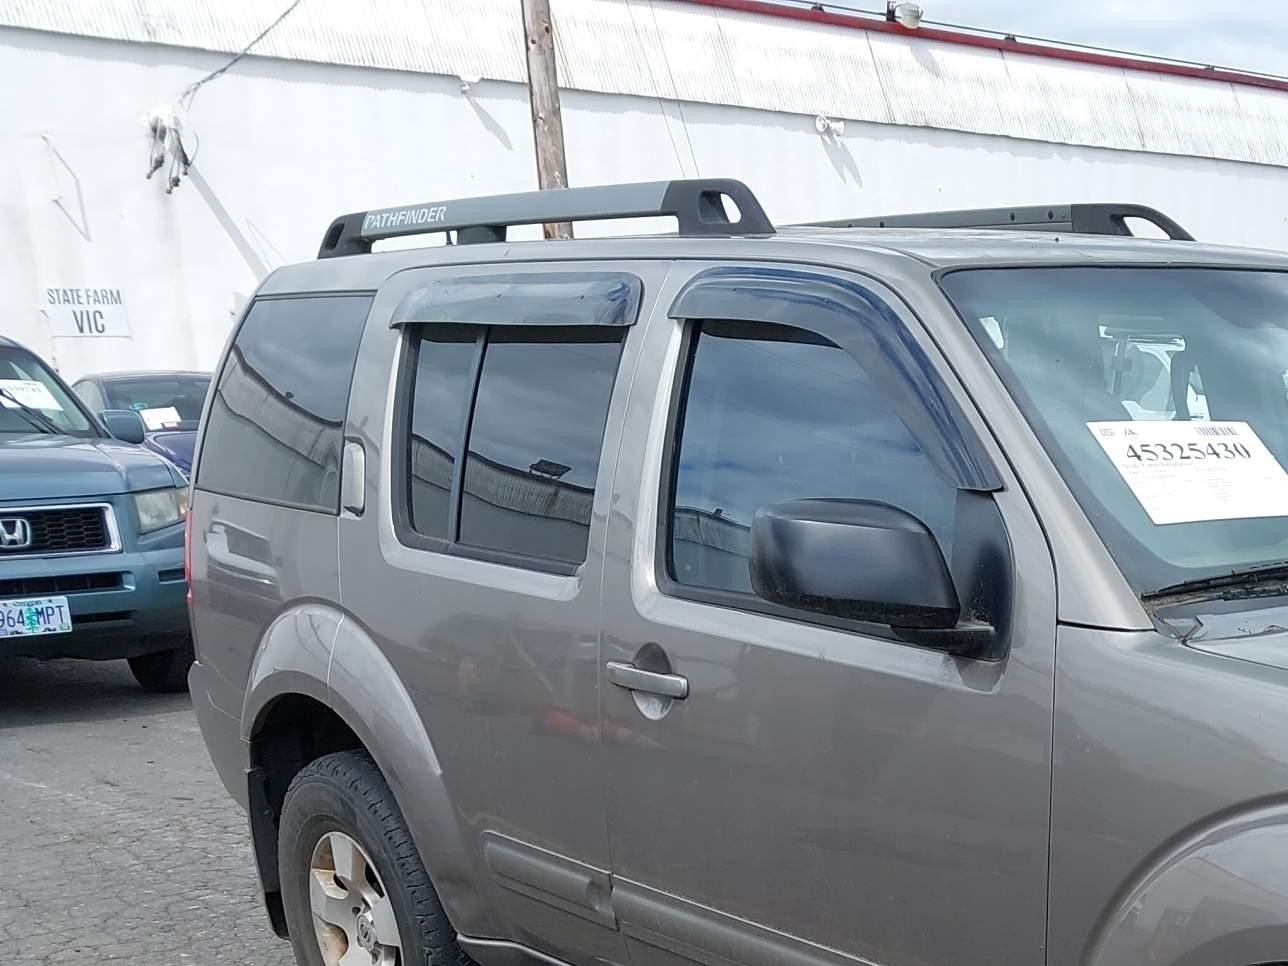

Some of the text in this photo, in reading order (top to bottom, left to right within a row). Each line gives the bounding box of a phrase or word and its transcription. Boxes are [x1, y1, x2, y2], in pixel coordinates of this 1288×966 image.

[364, 206, 447, 230] PATHFINDER
[47, 288, 122, 305] STATE FARM
[72, 310, 106, 334] VIC
[1126, 443, 1251, 461] 45325430
[35, 605, 64, 625] MPT
